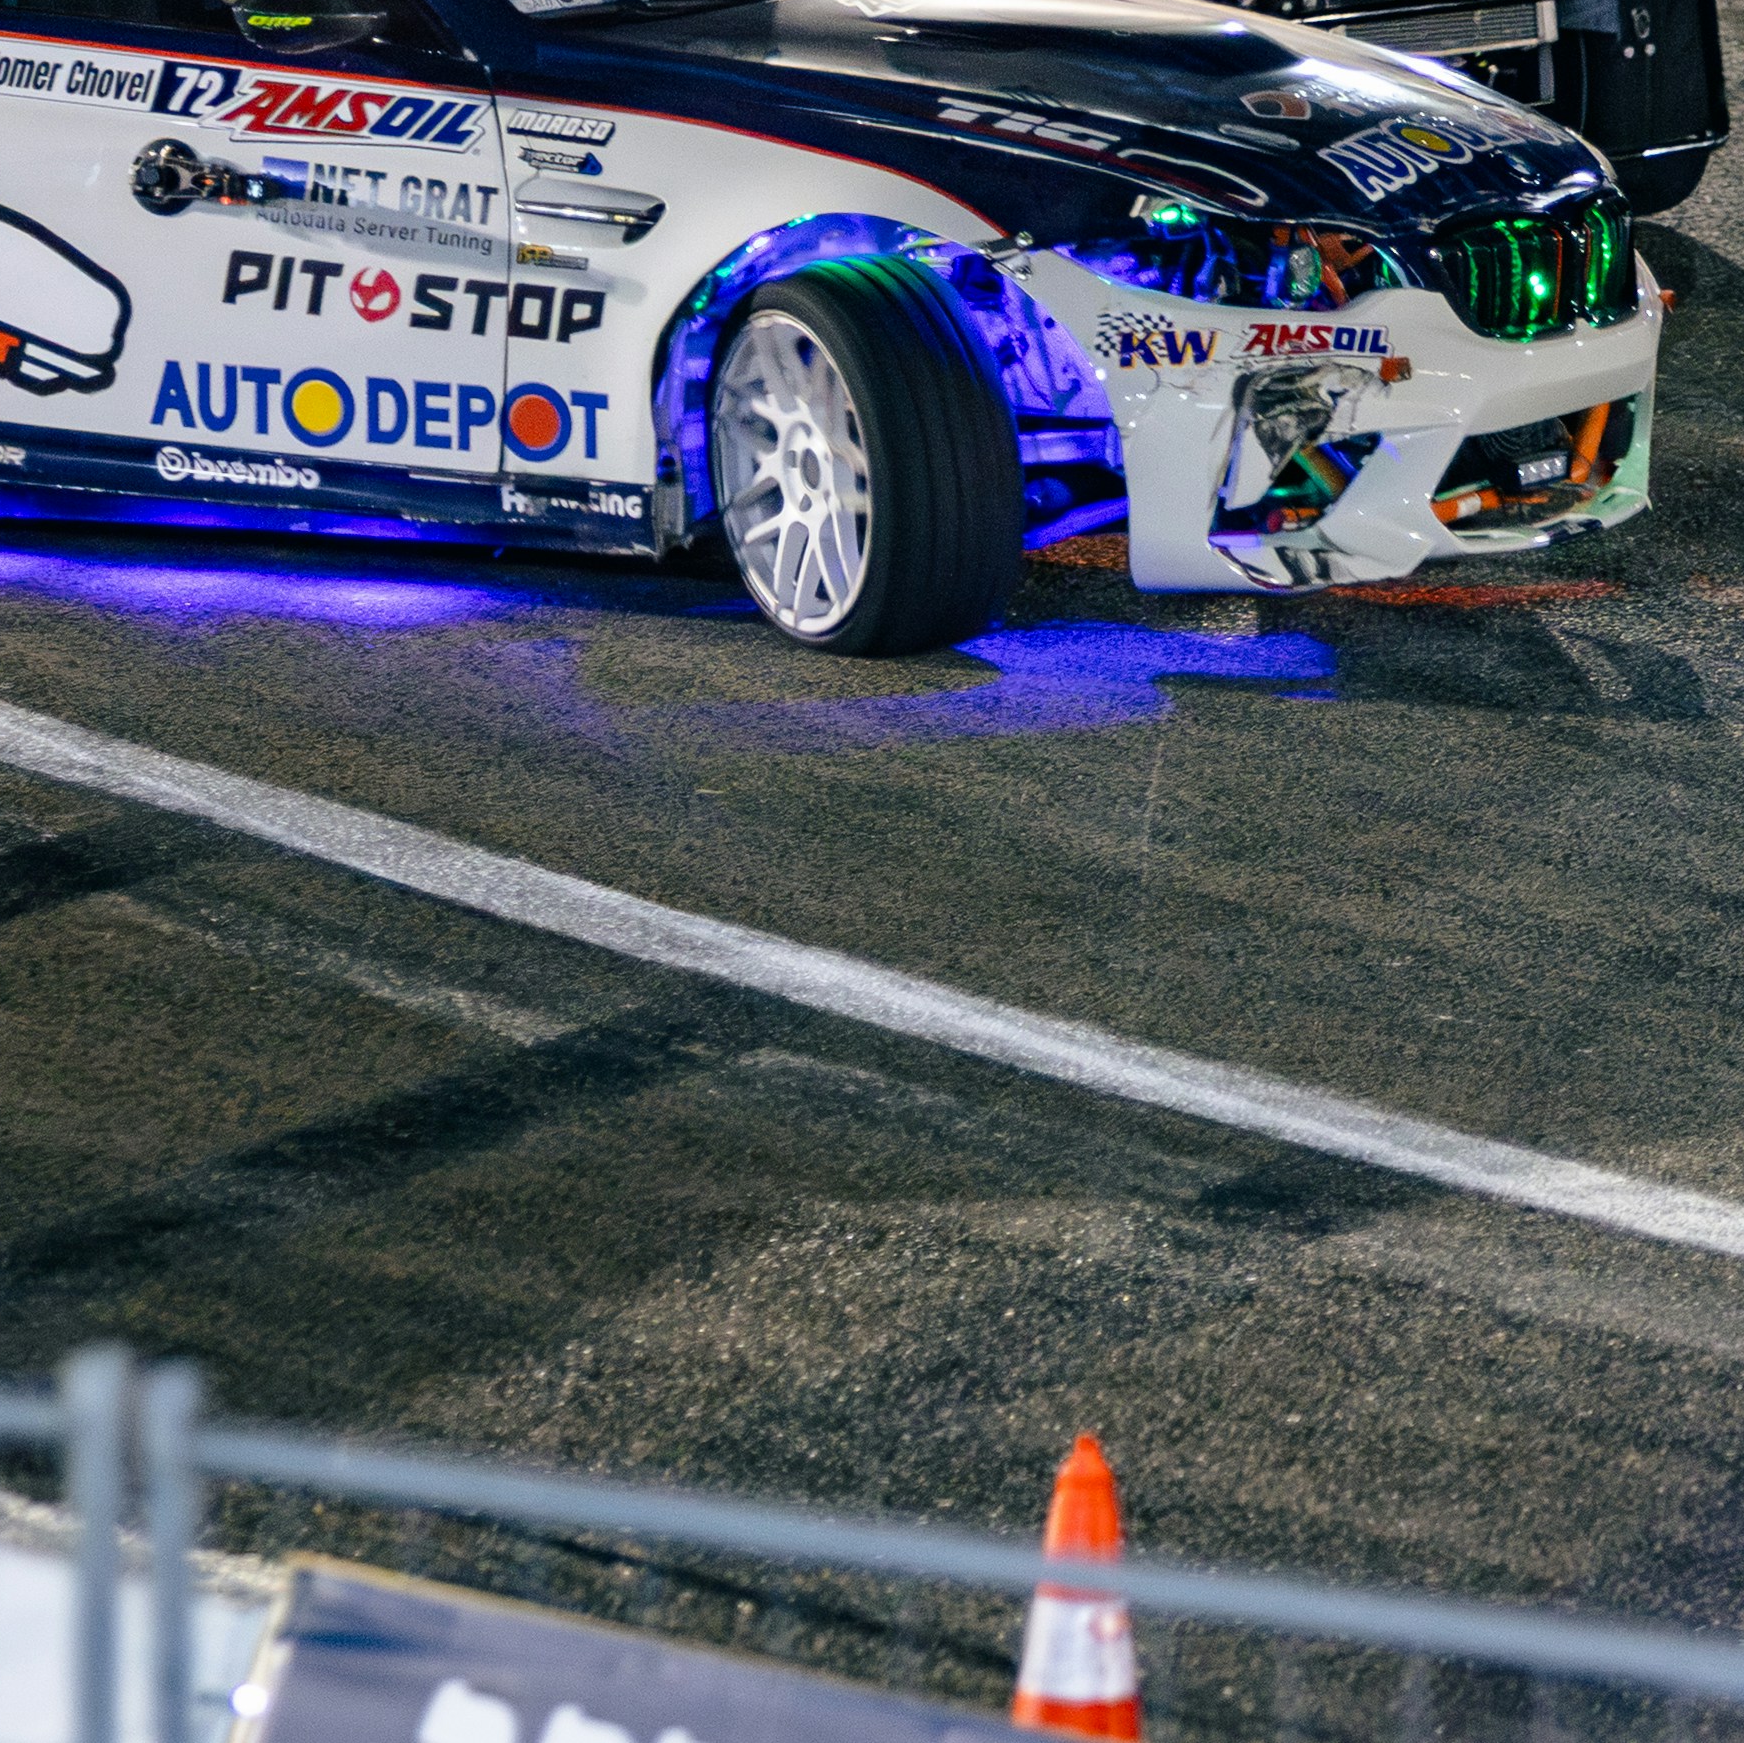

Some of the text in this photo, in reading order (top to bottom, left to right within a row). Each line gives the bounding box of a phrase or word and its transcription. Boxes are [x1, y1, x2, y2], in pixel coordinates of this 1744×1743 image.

[65, 60, 156, 105] Chovel
[166, 66, 226, 115] 72
[219, 79, 481, 145] AMSOIL
[310, 162, 388, 207] NET
[258, 205, 346, 233] Autodata
[353, 216, 420, 242] Server
[425, 226, 494, 256] Tuning
[222, 249, 607, 344] PIT STOP
[1118, 329, 1220, 369] KW
[1241, 323, 1390, 358] AMSOIL
[191, 451, 321, 490] brembo
